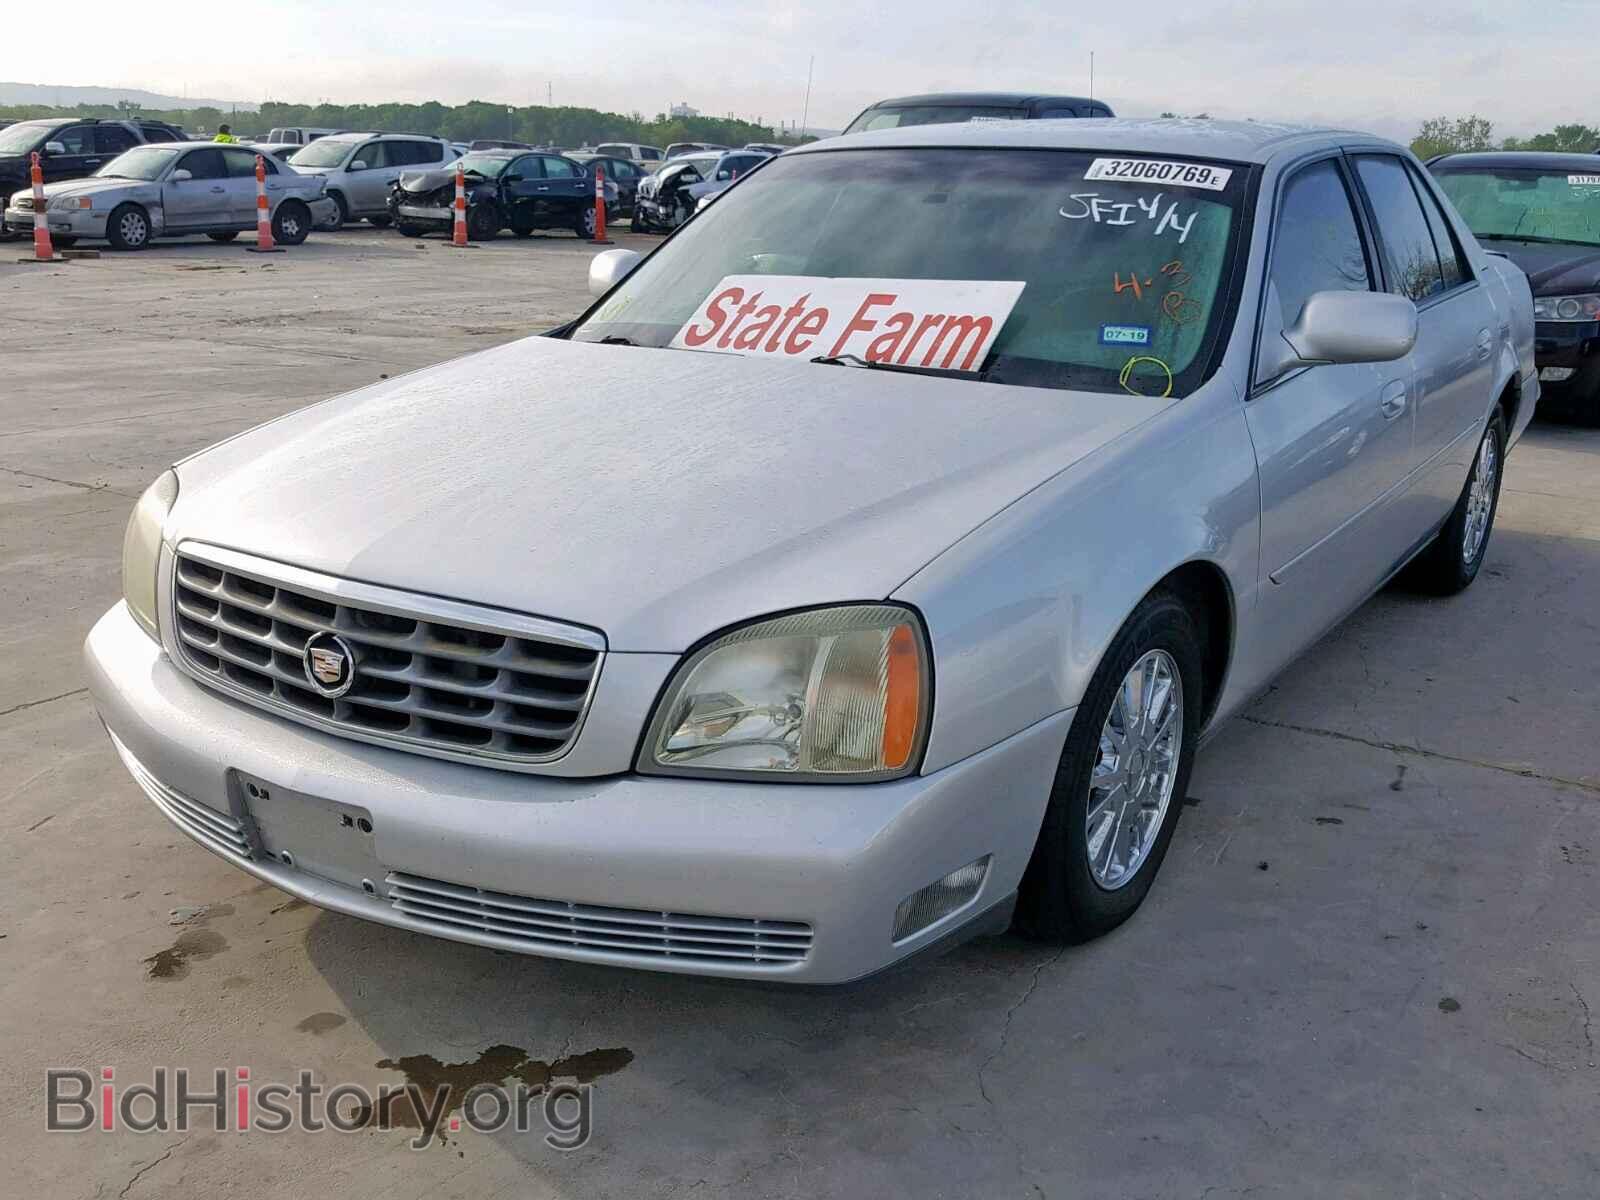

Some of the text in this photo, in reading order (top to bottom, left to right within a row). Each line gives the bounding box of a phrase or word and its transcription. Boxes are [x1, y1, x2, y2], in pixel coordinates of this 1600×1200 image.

[1105, 160, 1212, 184] 32060769
[684, 287, 994, 371] State Farm
[1106, 330, 1145, 339] 07-19
